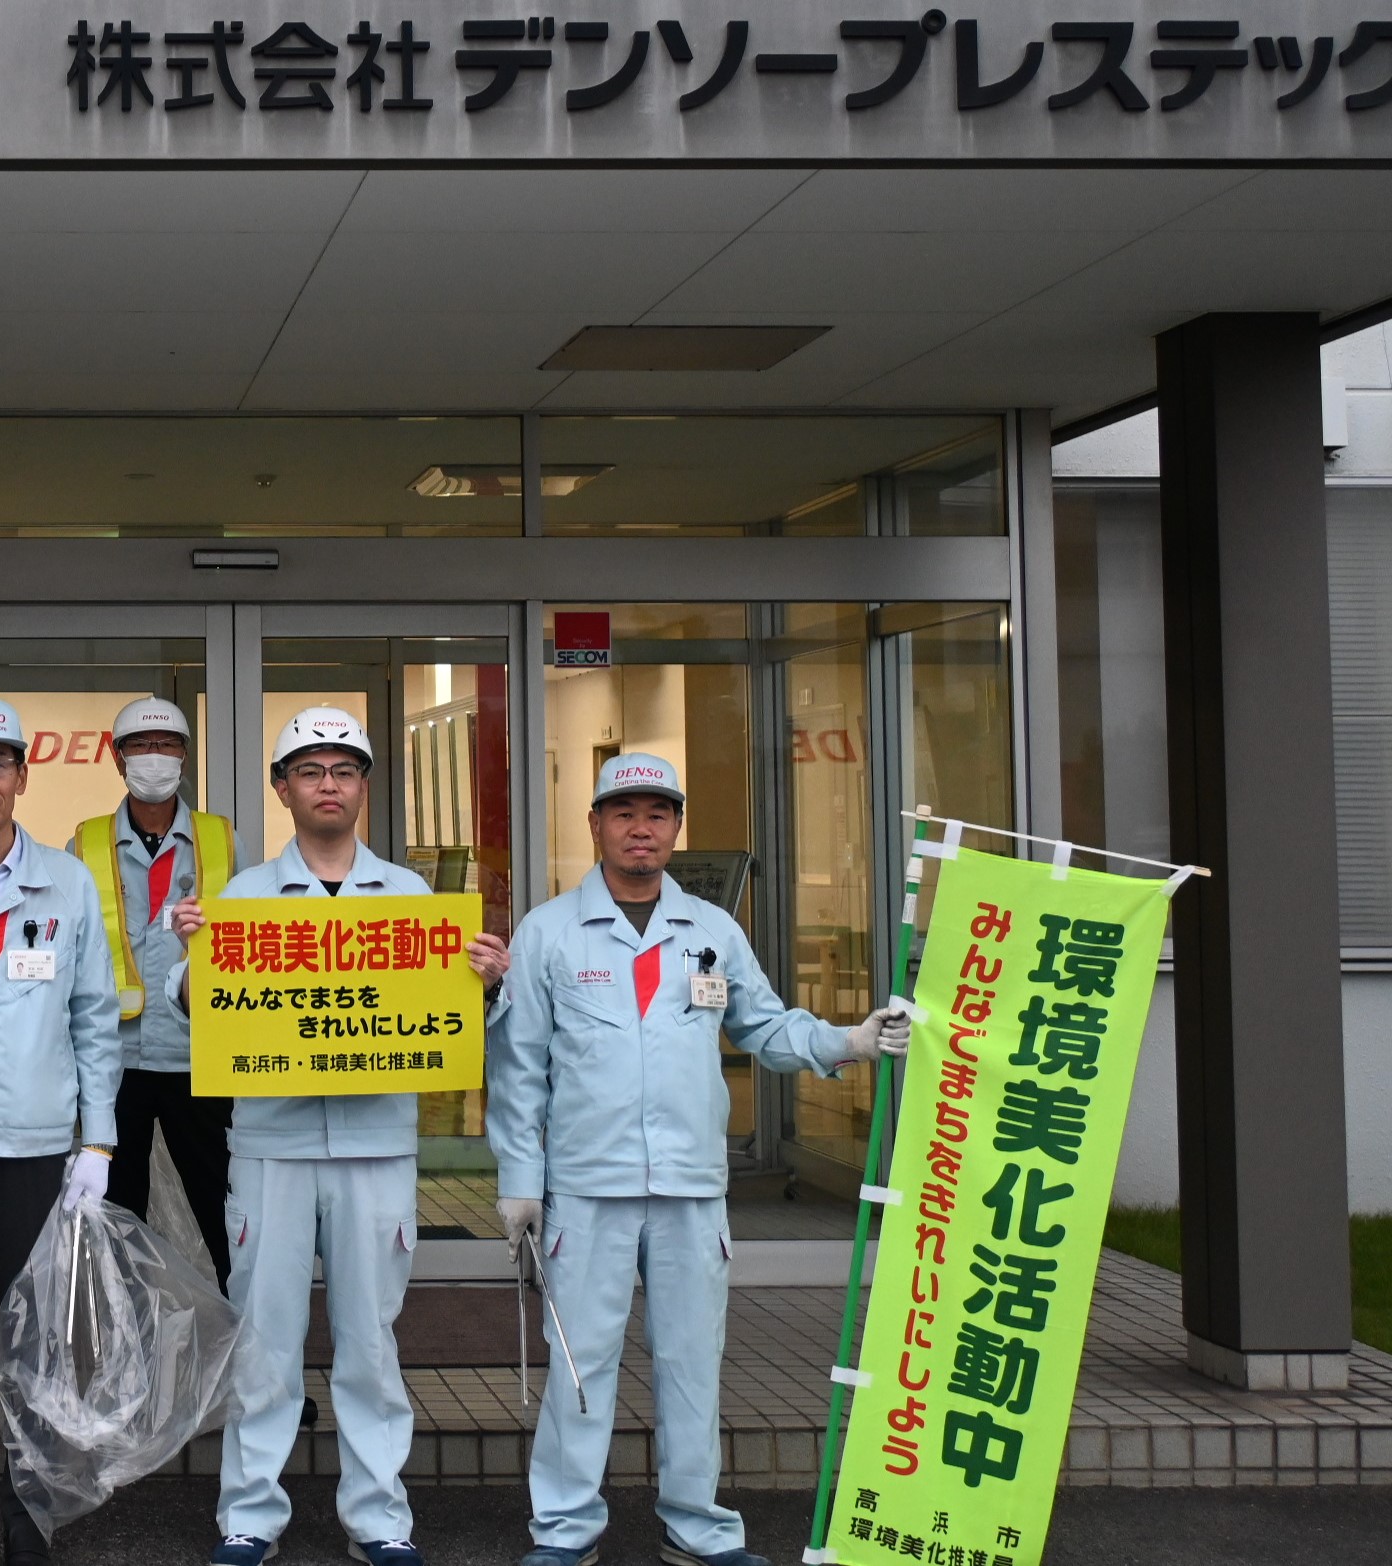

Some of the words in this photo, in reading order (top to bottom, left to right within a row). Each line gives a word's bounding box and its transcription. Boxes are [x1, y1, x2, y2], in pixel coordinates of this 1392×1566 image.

[557, 650, 608, 664] SECOM
[27, 731, 116, 764] DEN
[615, 766, 664, 780] DENSO
[210, 918, 462, 974] 環境美化活動中
[577, 970, 611, 979] DENSO
[210, 985, 380, 1011] みんなでまちを
[297, 1012, 463, 1039] きれいにしよう
[231, 1051, 444, 1074] 高浜市・環境美化推進員
[882, 902, 1011, 1477] みんなでまちをきれいにしよう
[941, 912, 1125, 1489] 環境美化活動中
